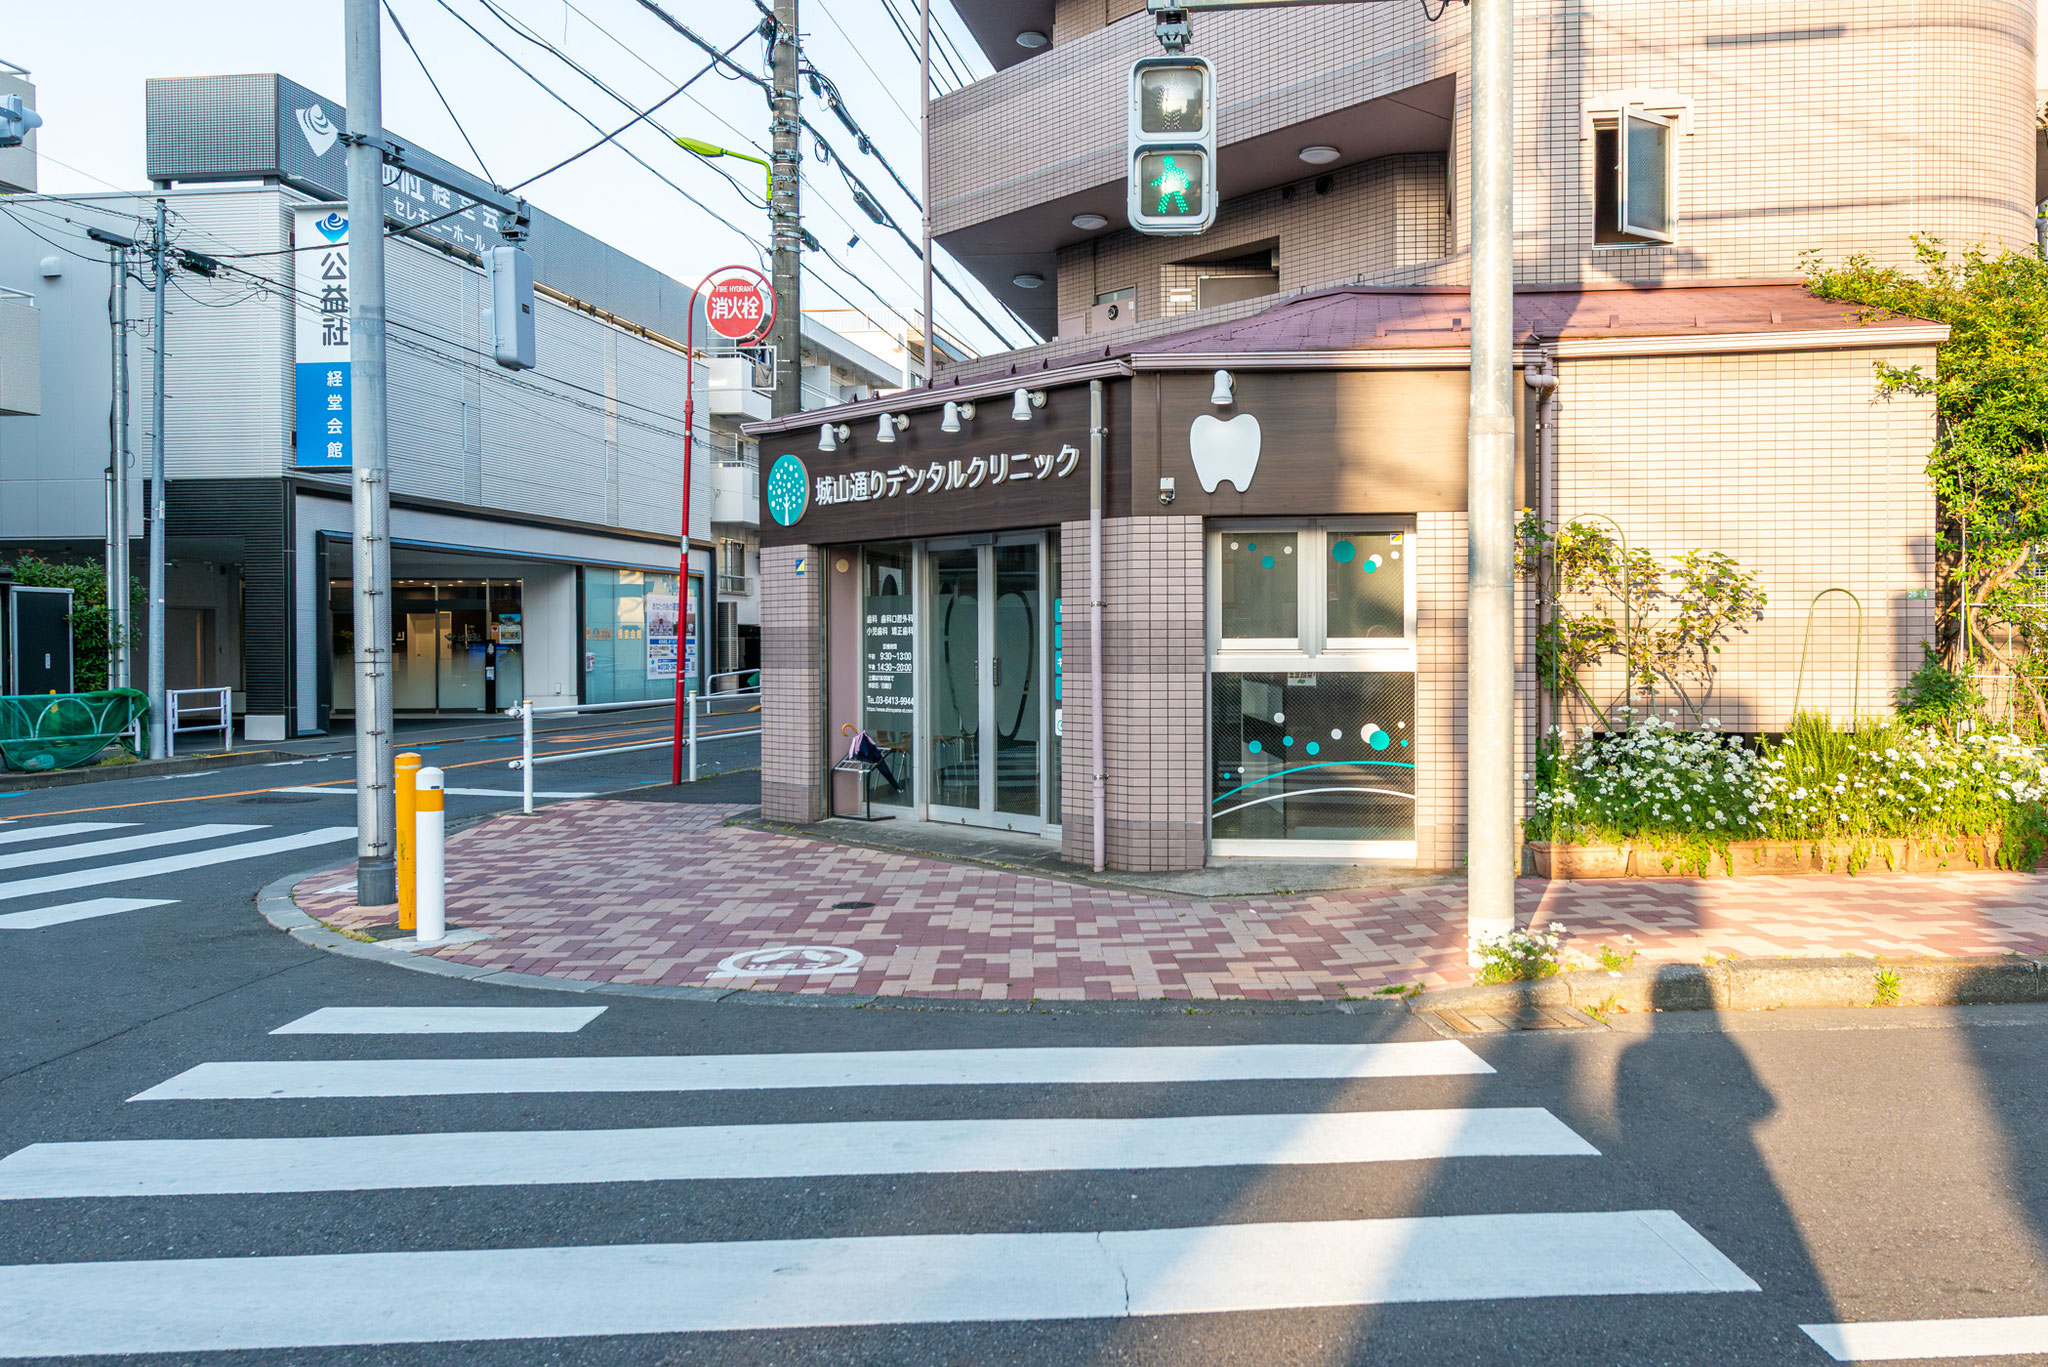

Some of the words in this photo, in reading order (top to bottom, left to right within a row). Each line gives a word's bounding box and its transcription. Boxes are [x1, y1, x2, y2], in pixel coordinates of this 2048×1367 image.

[393, 195, 486, 251] セレモニーホール
[320, 252, 349, 346] 公益社
[711, 295, 760, 320] 消火栓
[715, 285, 729, 293] FIRE
[729, 285, 755, 293] HYDRANT
[326, 370, 343, 458] 経堂会館
[815, 443, 1080, 506] 城山通りデンタルクリニック
[867, 614, 877, 623] 歯科
[867, 626, 888, 635] 小児歯科
